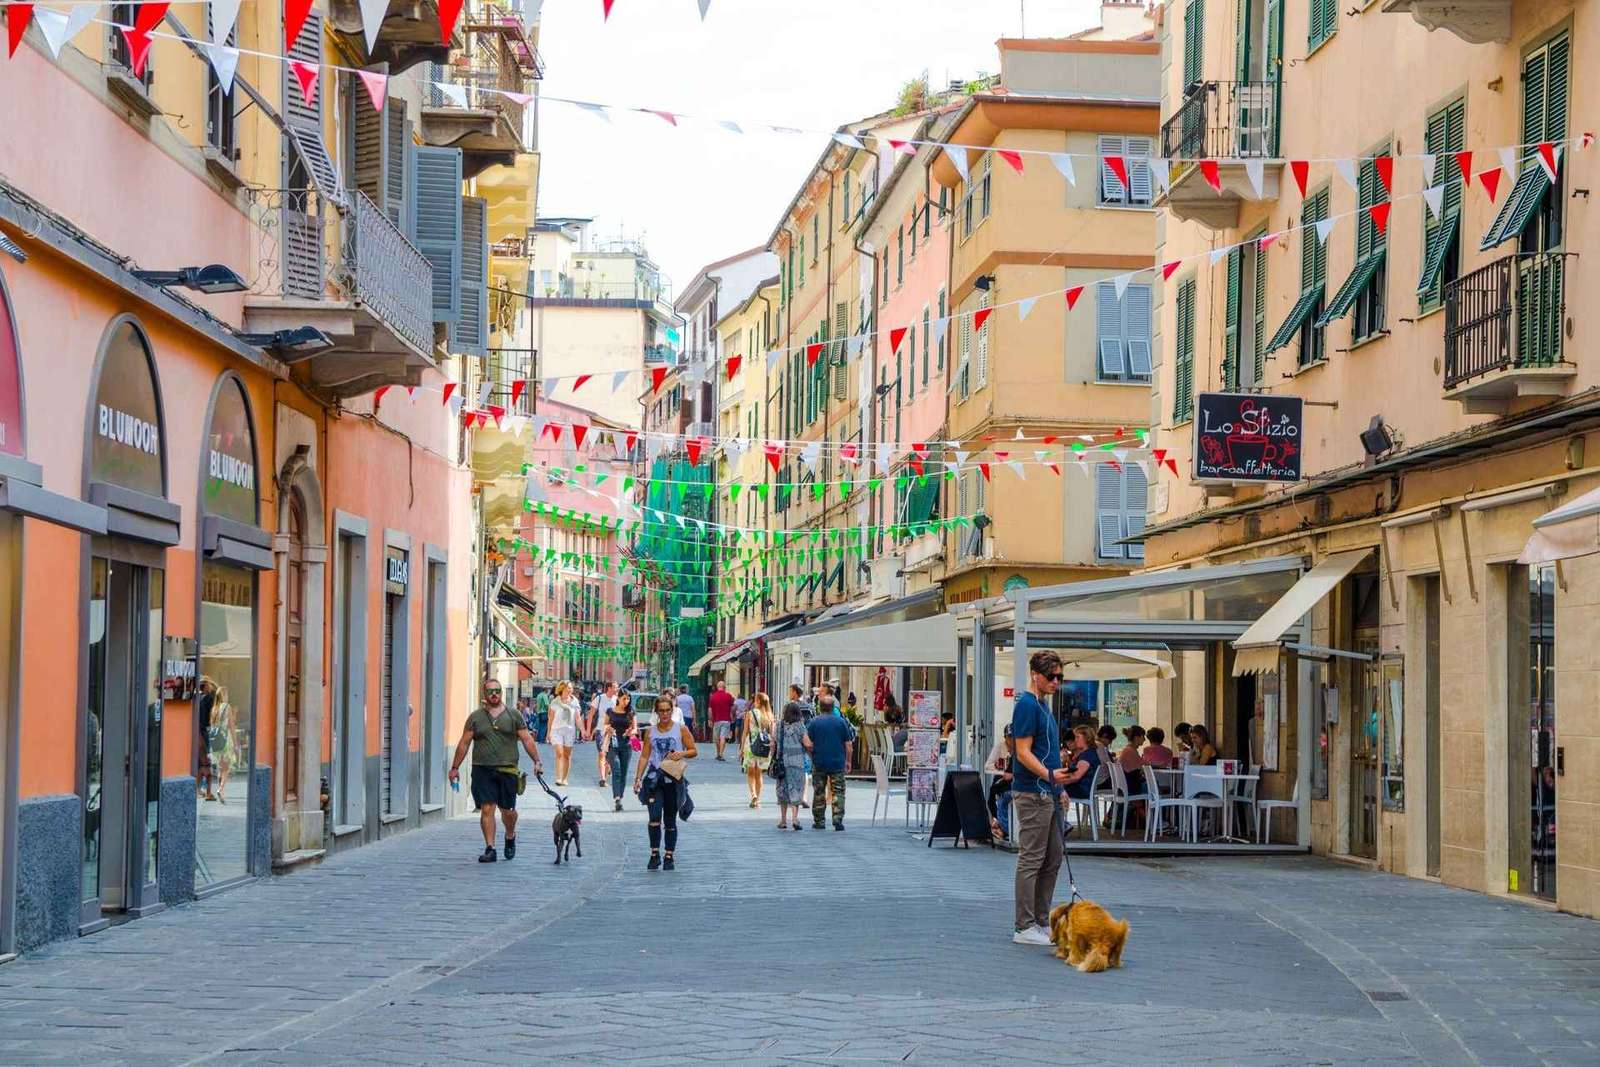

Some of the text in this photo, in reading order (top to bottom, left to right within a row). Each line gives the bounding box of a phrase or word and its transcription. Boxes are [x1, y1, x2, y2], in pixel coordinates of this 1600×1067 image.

[99, 404, 158, 455] BLUMOON
[1203, 407, 1298, 437] Lo Sfizio
[210, 449, 253, 490] BLUMOON
